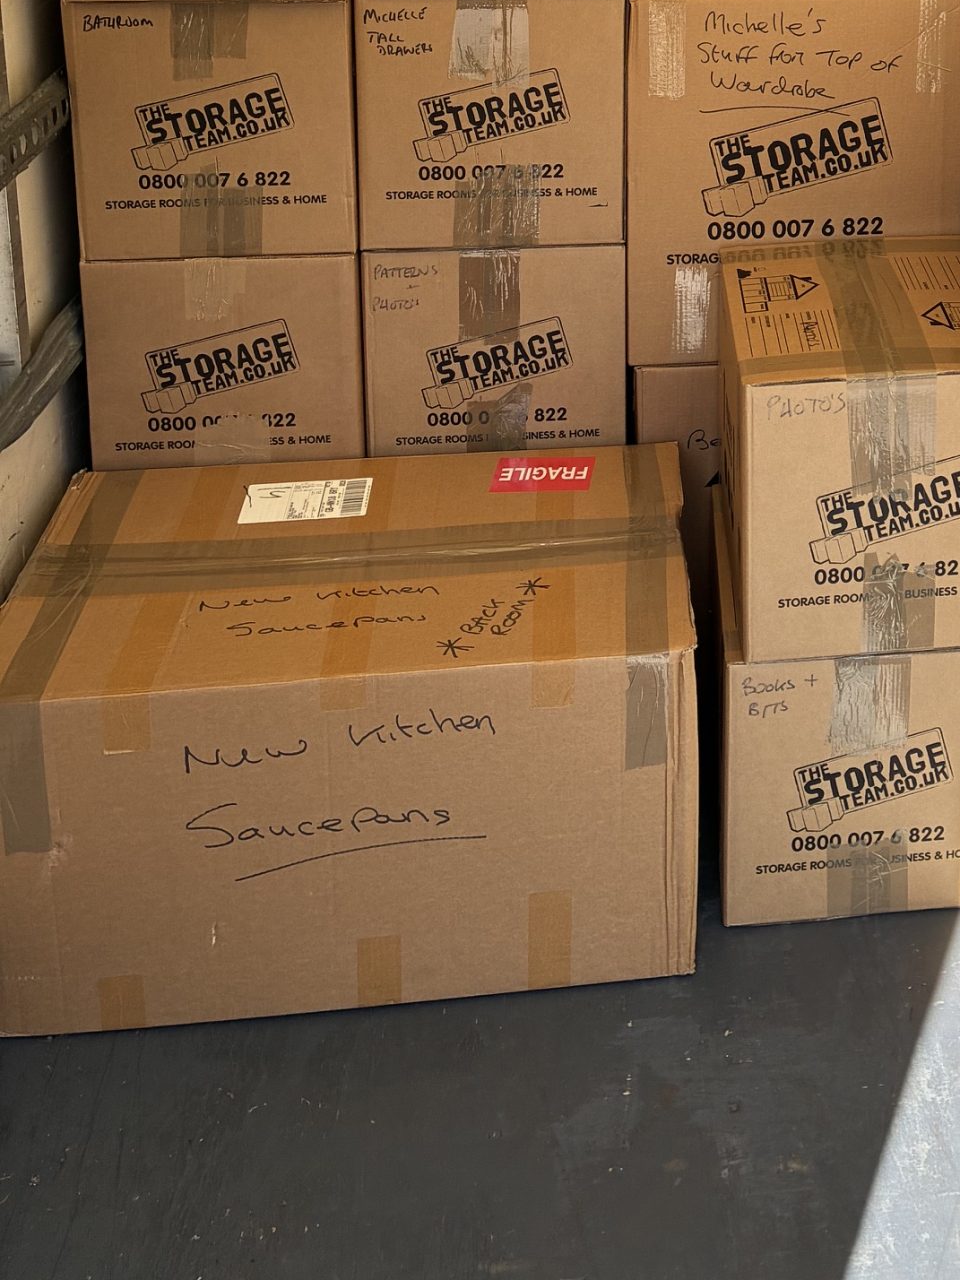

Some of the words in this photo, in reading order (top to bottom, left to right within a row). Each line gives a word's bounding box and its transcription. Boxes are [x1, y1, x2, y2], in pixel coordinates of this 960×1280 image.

[139, 104, 170, 121] THE
[146, 87, 285, 145] STORAGE
[422, 96, 451, 115] THE
[428, 82, 563, 136] STORAGE
[463, 103, 566, 144] TEAM.CO.UK
[183, 111, 290, 152] TEAM.CO.UK
[714, 135, 751, 156] THE
[721, 115, 885, 184] STORAGE
[763, 142, 888, 192] TEAM.CO.UK
[708, 221, 765, 240] 0800
[773, 219, 815, 239] 007
[821, 219, 834, 236] 6
[842, 217, 883, 235] 822
[430, 346, 461, 364] THE
[436, 330, 566, 384] STORAGE
[470, 352, 570, 390] TEAM.CO.UK
[499, 465, 588, 481] FRAGILE
[821, 492, 854, 511] THE
[799, 763, 829, 783] THE
[804, 742, 946, 804] STORAGE
[841, 765, 950, 810] TEAM.CO.UK
